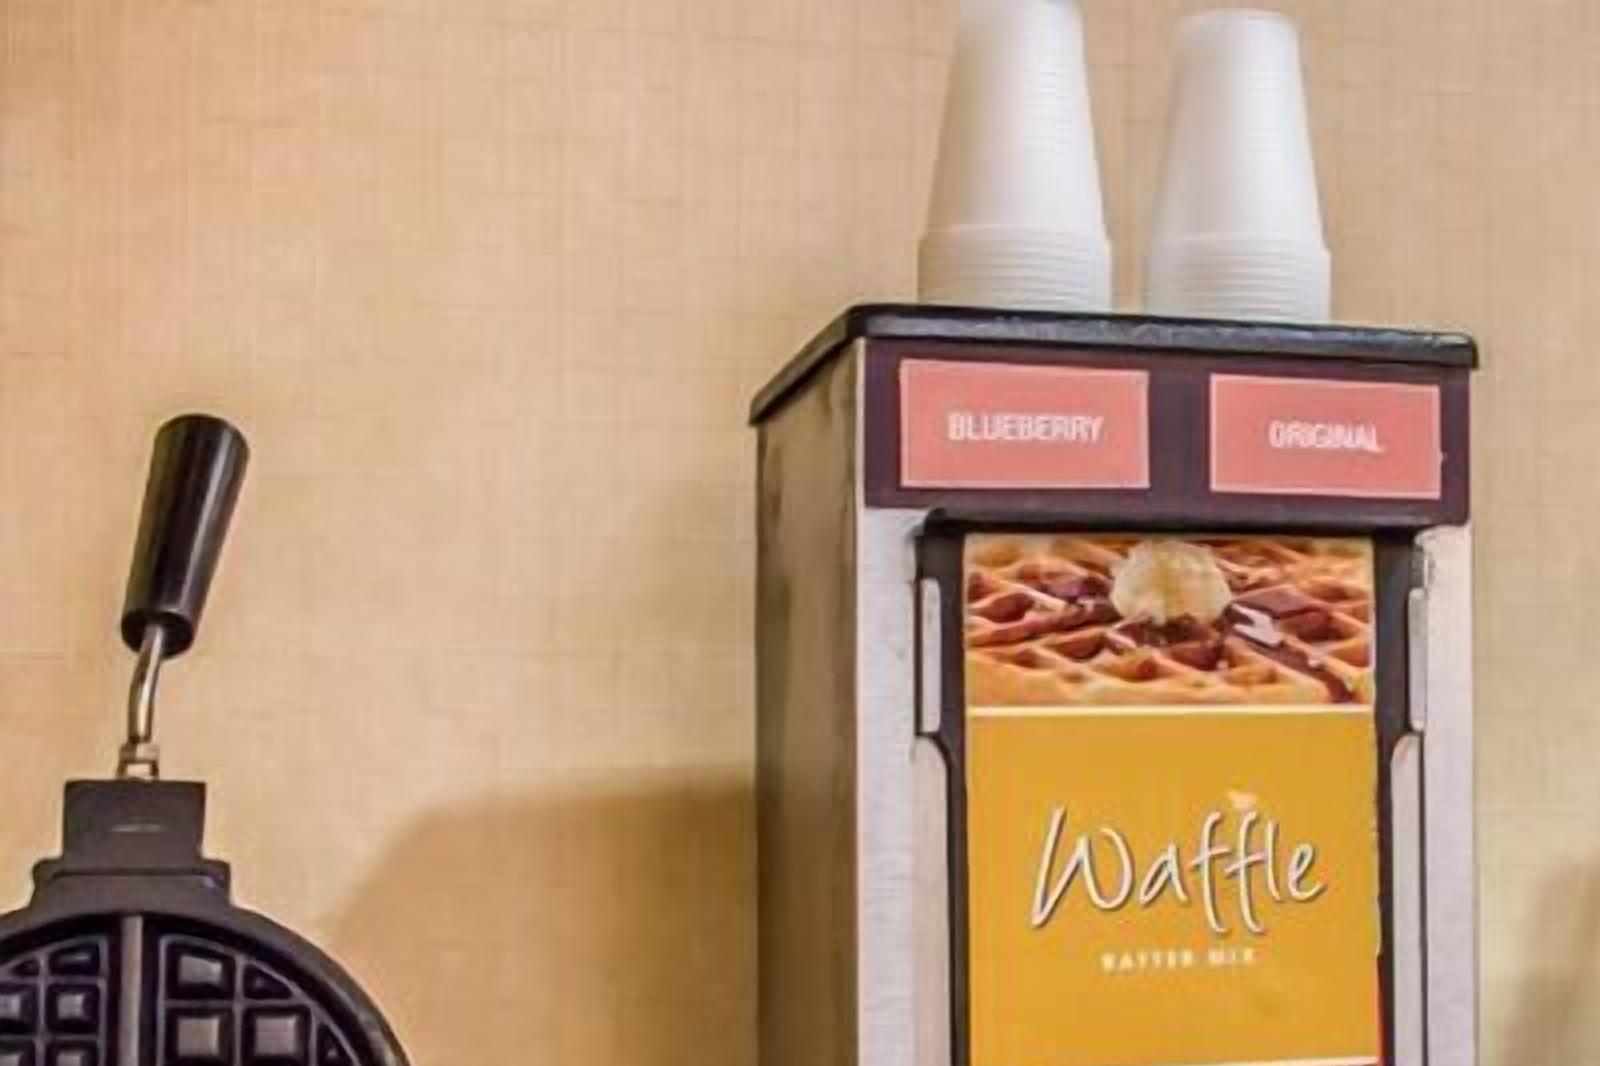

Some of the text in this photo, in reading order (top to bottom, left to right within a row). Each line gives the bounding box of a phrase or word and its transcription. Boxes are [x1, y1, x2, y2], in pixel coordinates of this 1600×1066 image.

[948, 411, 1105, 443] BLUEBERRY
[1268, 420, 1386, 454] ORIGINAL
[1030, 804, 1327, 934] Waffle
